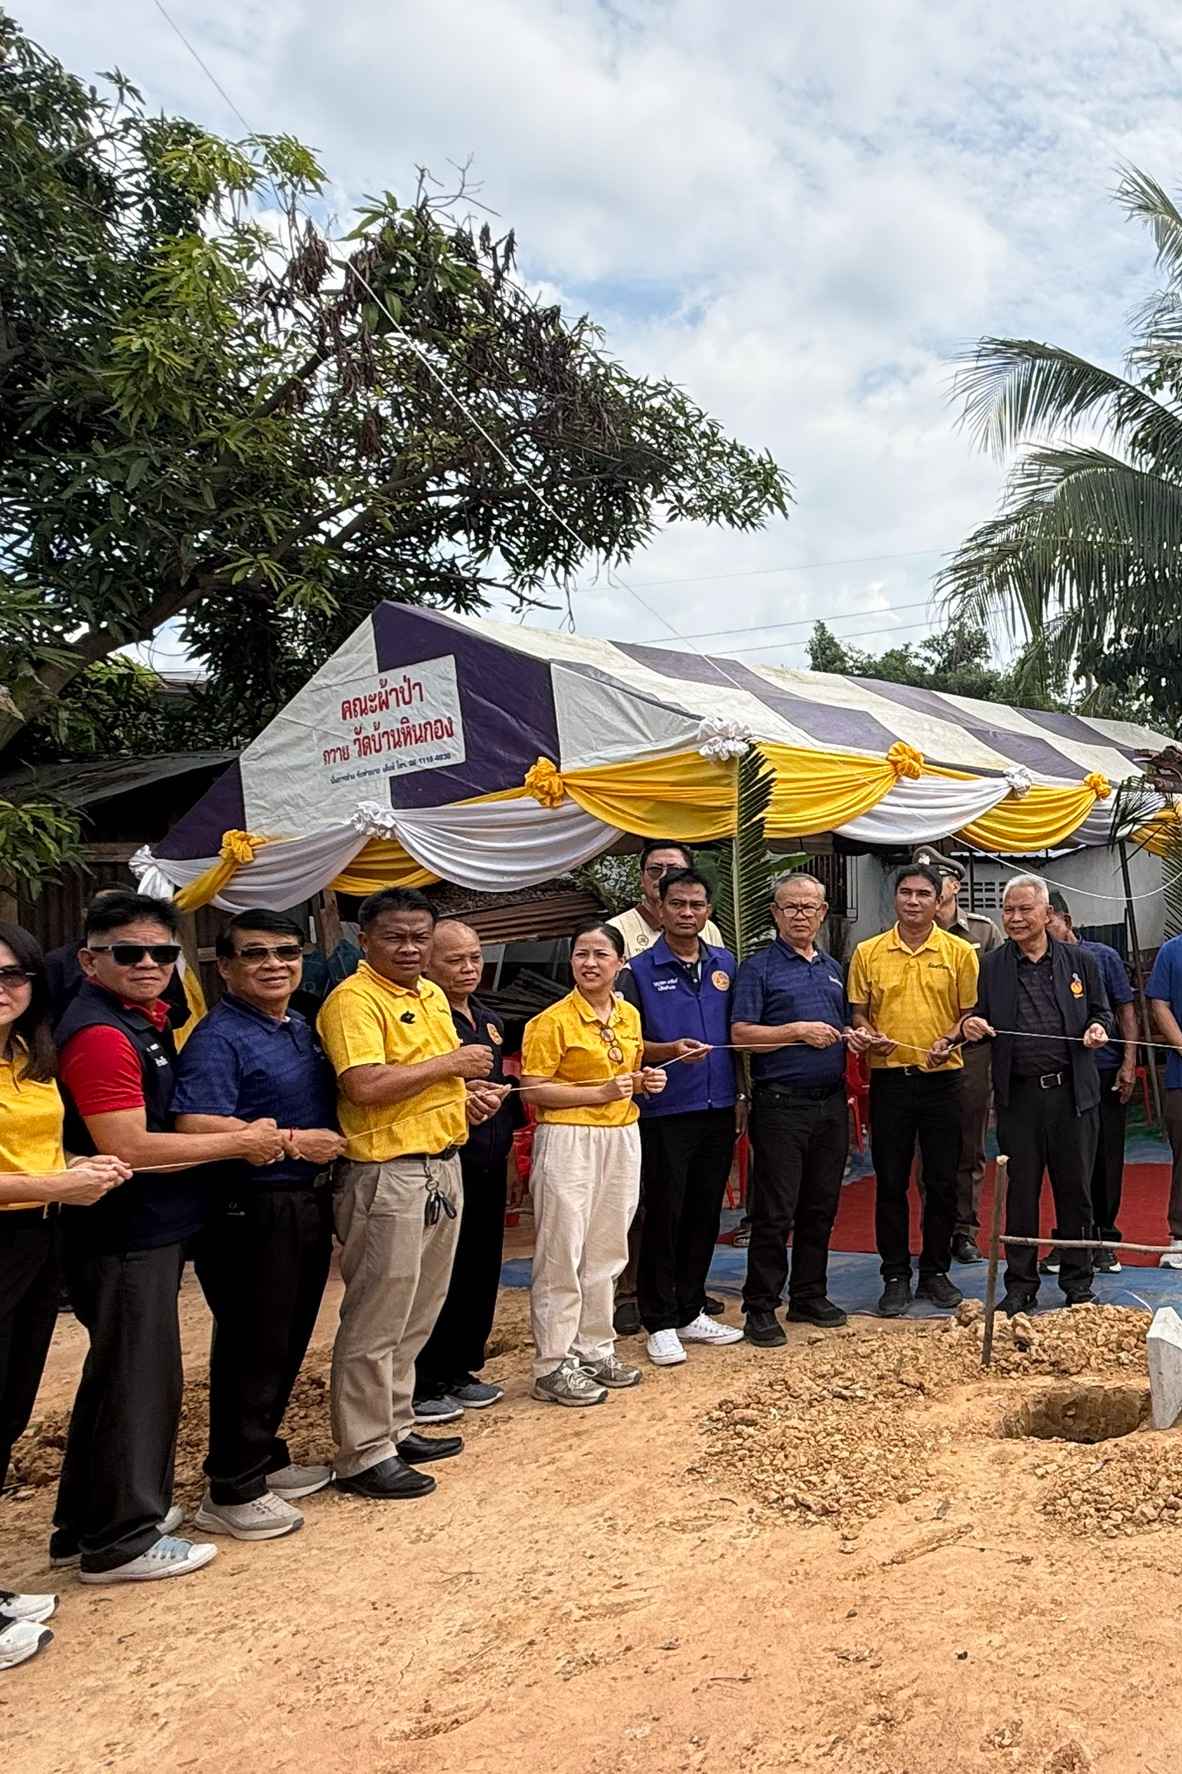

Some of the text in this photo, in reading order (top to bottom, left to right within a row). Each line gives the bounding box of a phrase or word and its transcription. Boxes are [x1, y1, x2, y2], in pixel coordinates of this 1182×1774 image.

[341, 675, 424, 720] คณะผ้าป่า
[322, 716, 455, 765] ถวาย วัดบ้านหินกอง
